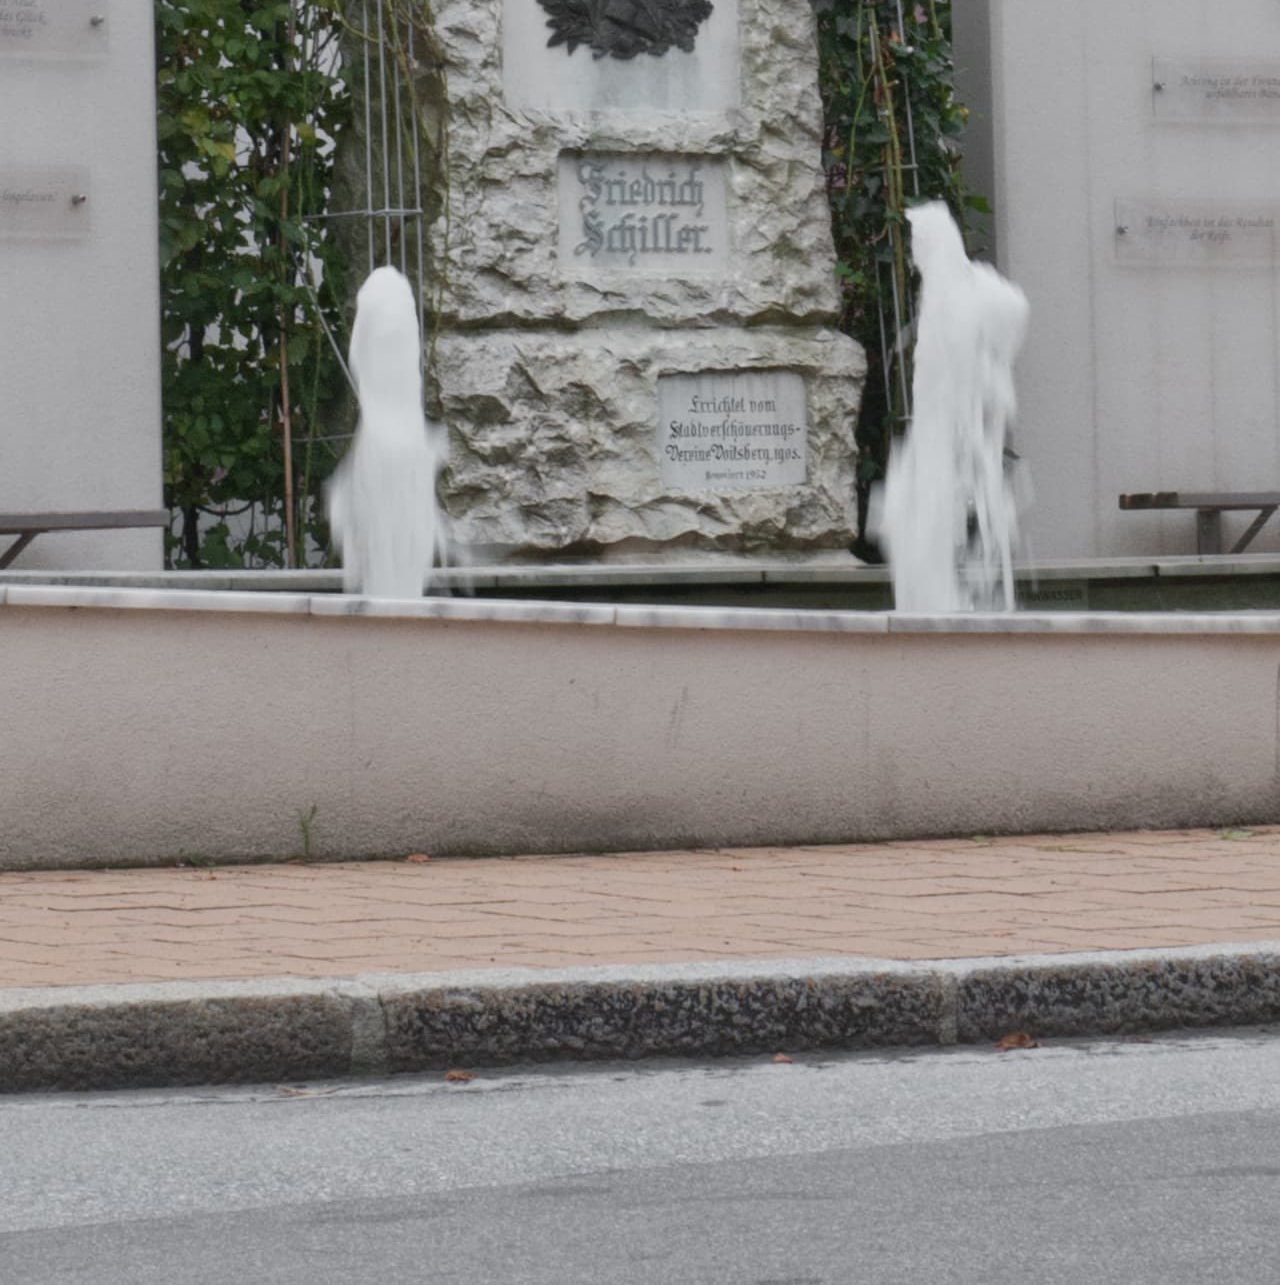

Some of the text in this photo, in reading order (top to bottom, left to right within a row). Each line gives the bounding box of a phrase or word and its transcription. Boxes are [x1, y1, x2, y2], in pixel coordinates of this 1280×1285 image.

[576, 164, 705, 217] Friedrich
[573, 210, 713, 265] Schiller.
[688, 395, 776, 418] Errichtet vom
